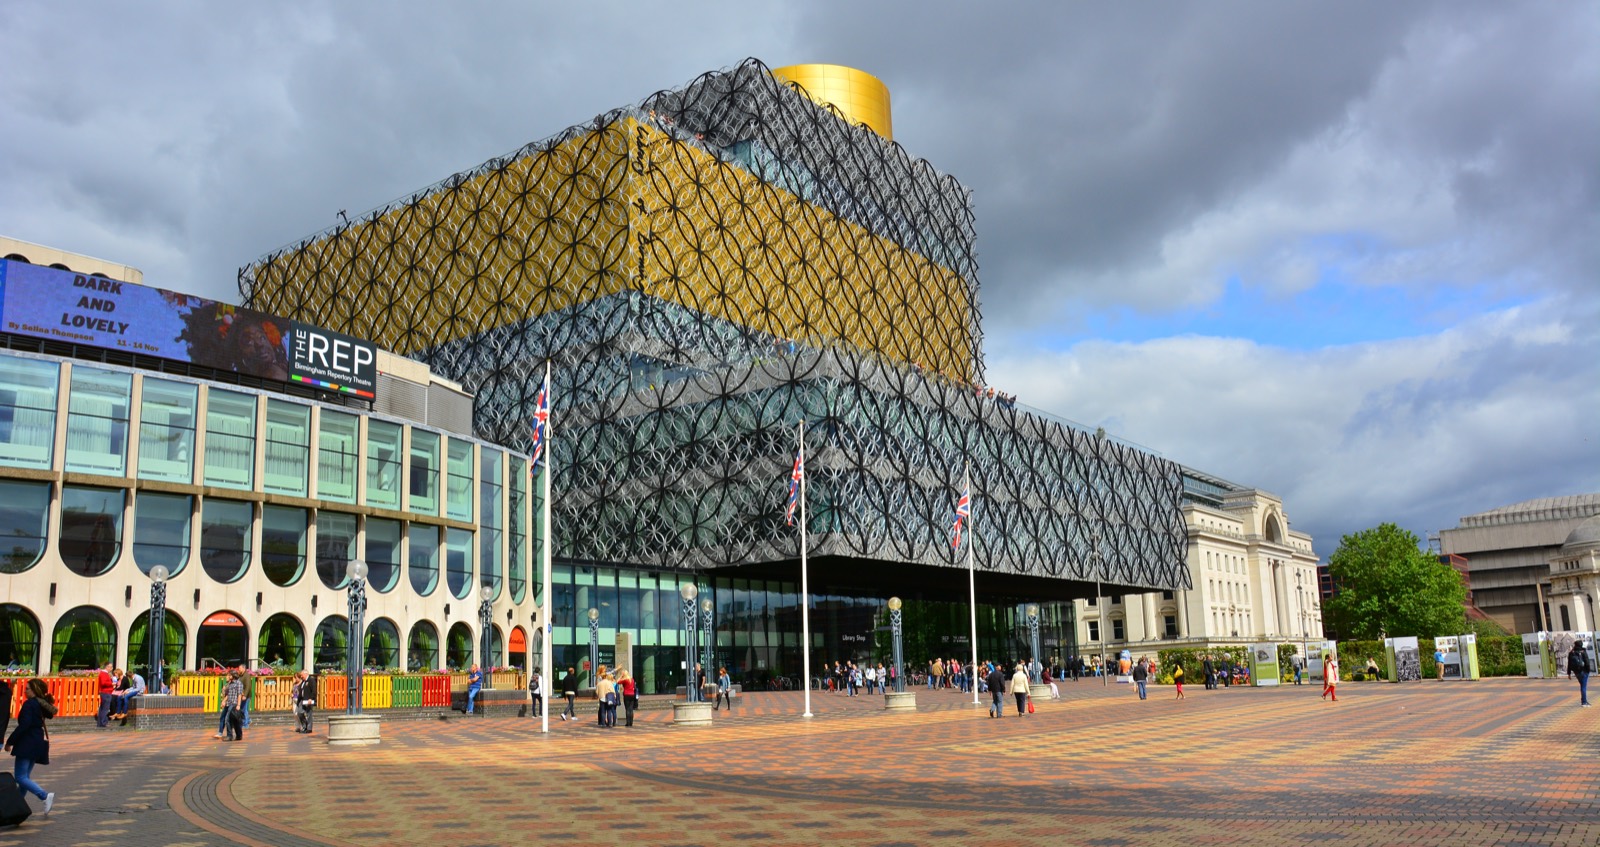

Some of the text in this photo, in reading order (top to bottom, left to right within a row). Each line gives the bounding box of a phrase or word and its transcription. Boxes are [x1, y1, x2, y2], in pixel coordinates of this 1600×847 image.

[73, 275, 124, 295] DARK
[77, 296, 116, 312] AND
[8, 321, 94, 341] By Selina Thompson
[61, 313, 129, 335] LOVELY
[117, 339, 125, 347] 11
[133, 341, 143, 349] 14
[144, 344, 159, 352] Nov
[295, 328, 306, 360] THE
[308, 332, 373, 375] REP
[294, 361, 372, 387] Birmingham Repertory Theatre
[842, 634, 866, 643] Library Shop
